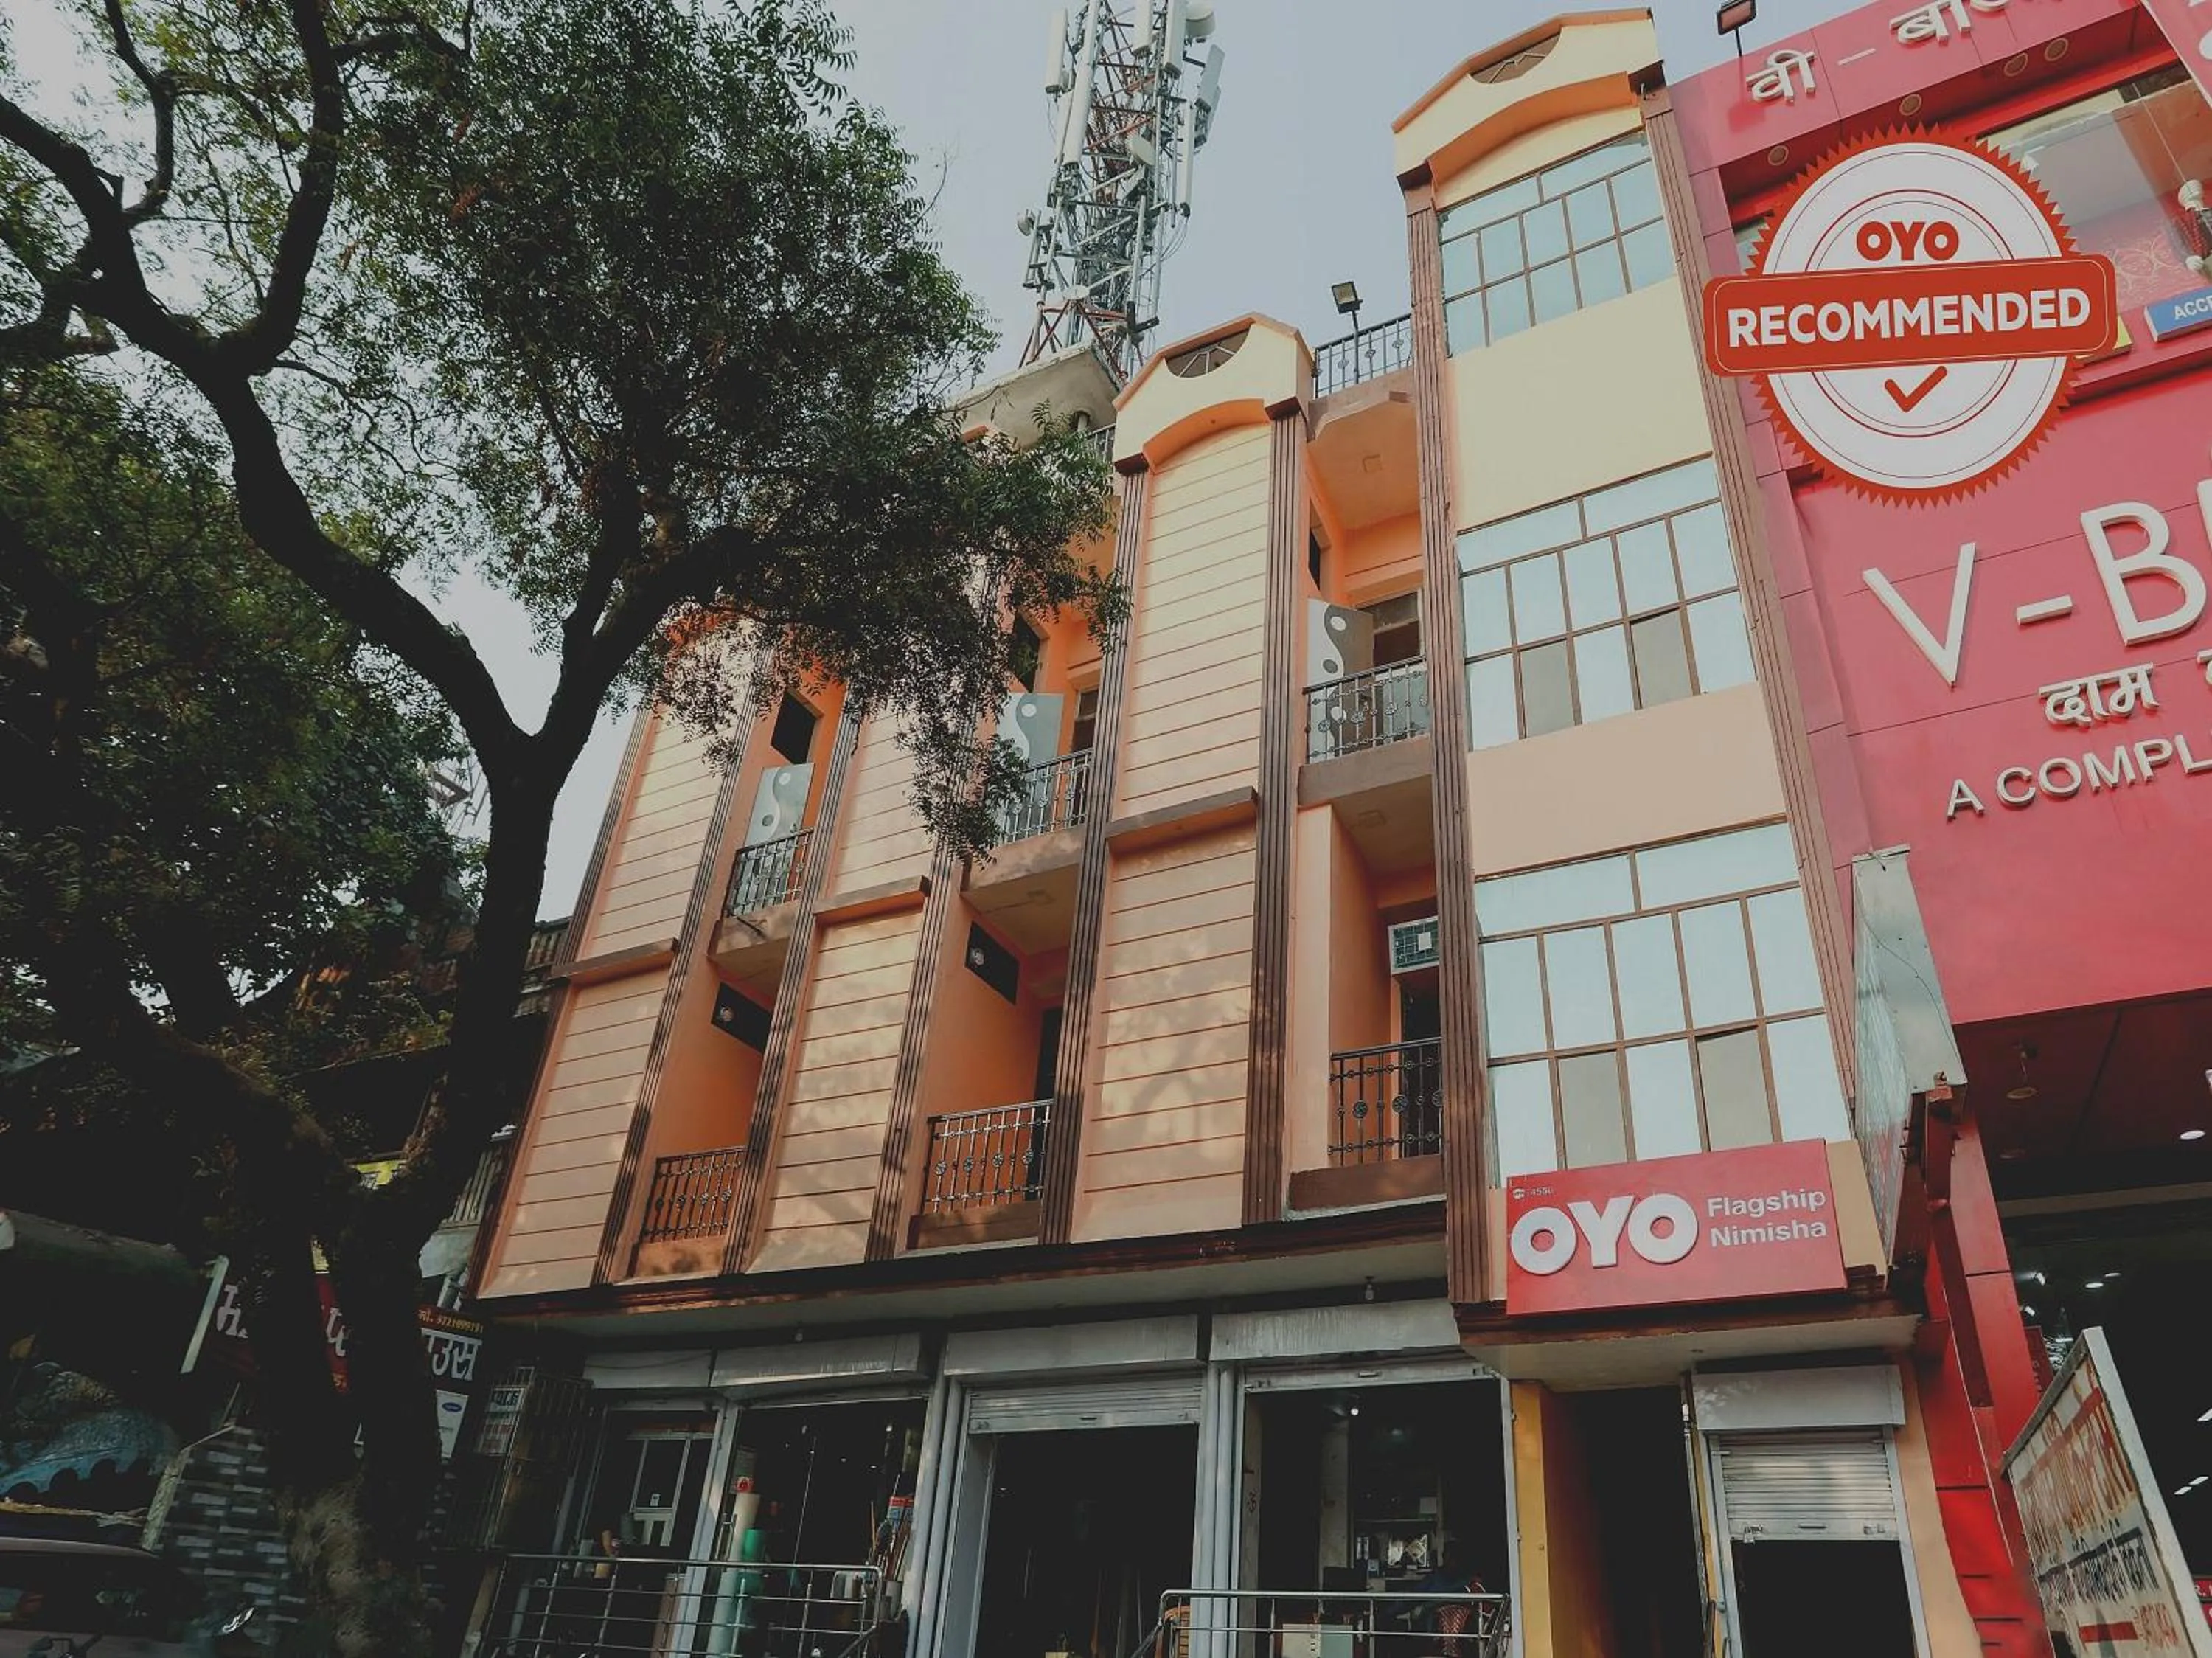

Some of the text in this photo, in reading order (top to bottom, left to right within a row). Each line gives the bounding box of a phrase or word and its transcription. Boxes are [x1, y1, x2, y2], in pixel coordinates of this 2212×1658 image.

[1862, 478, 2212, 689] V-B
[2038, 662, 2160, 729] दाम
[1946, 730, 2212, 823] A COMPL
[1510, 1193, 1700, 1277] OYO
[1706, 1187, 1827, 1218] Flagship
[1709, 1221, 1828, 1248] Nimisha
[421, 1327, 483, 1381] ाउस
